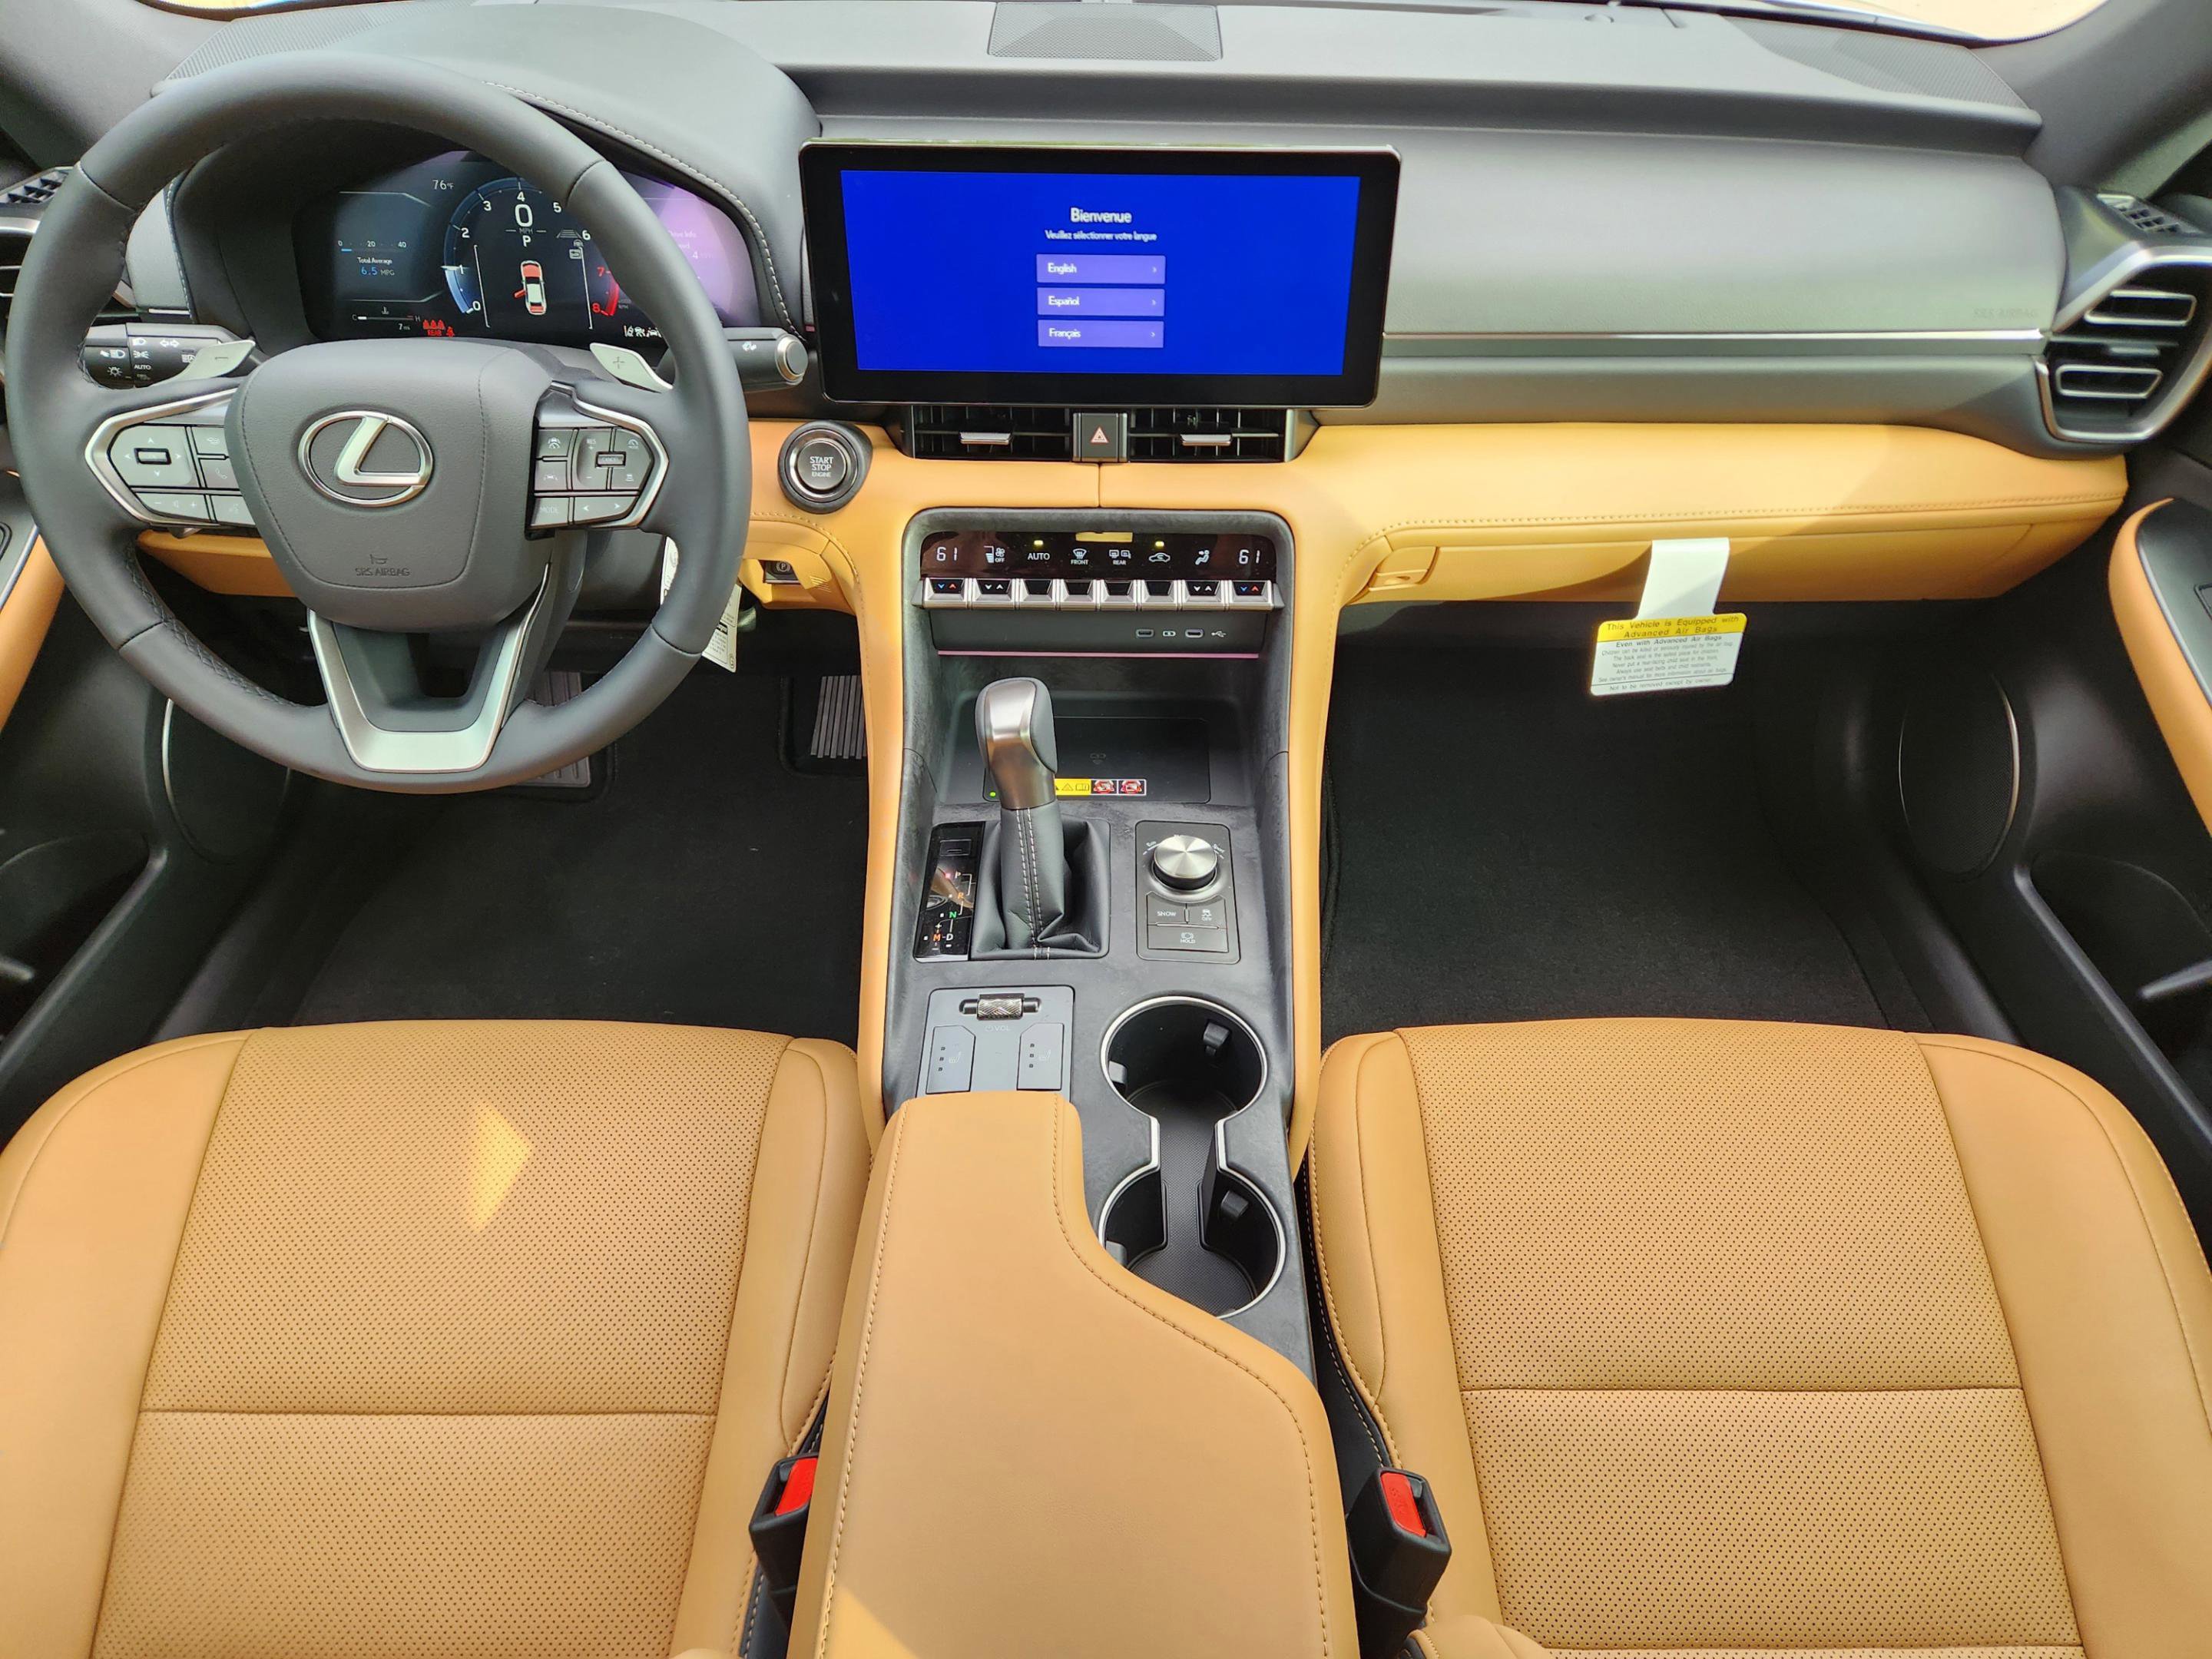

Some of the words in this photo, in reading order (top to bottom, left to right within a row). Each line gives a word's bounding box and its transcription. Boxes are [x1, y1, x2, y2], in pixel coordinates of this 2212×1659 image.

[516, 191, 525, 202] 4
[482, 200, 492, 211] 3
[553, 202, 562, 213] 5
[515, 204, 533, 227] 0
[1070, 207, 1132, 224] Bienvenue
[461, 227, 470, 238] 2
[581, 230, 591, 240] 6
[1045, 230, 1072, 240] Veuillez
[1073, 230, 1114, 240] sélectionner
[1114, 232, 1132, 240] votre
[1133, 230, 1157, 242] langue
[522, 235, 531, 247] P
[361, 267, 378, 276] 6.5
[597, 267, 605, 276] 7
[1048, 263, 1077, 274] English
[472, 301, 481, 310] 0
[1048, 296, 1080, 306] Español
[591, 303, 601, 313] 8
[1048, 328, 1081, 339] Français
[935, 547, 958, 561] 61
[1238, 549, 1260, 565] 61
[355, 568, 373, 576] SRS
[375, 568, 410, 576] AIRBAG
[1629, 621, 1660, 629] Vehicle
[1677, 618, 1717, 626] Equipped
[1624, 629, 1669, 638] Advanced
[1654, 637, 1687, 645] Advanced
[946, 932, 954, 941] D
